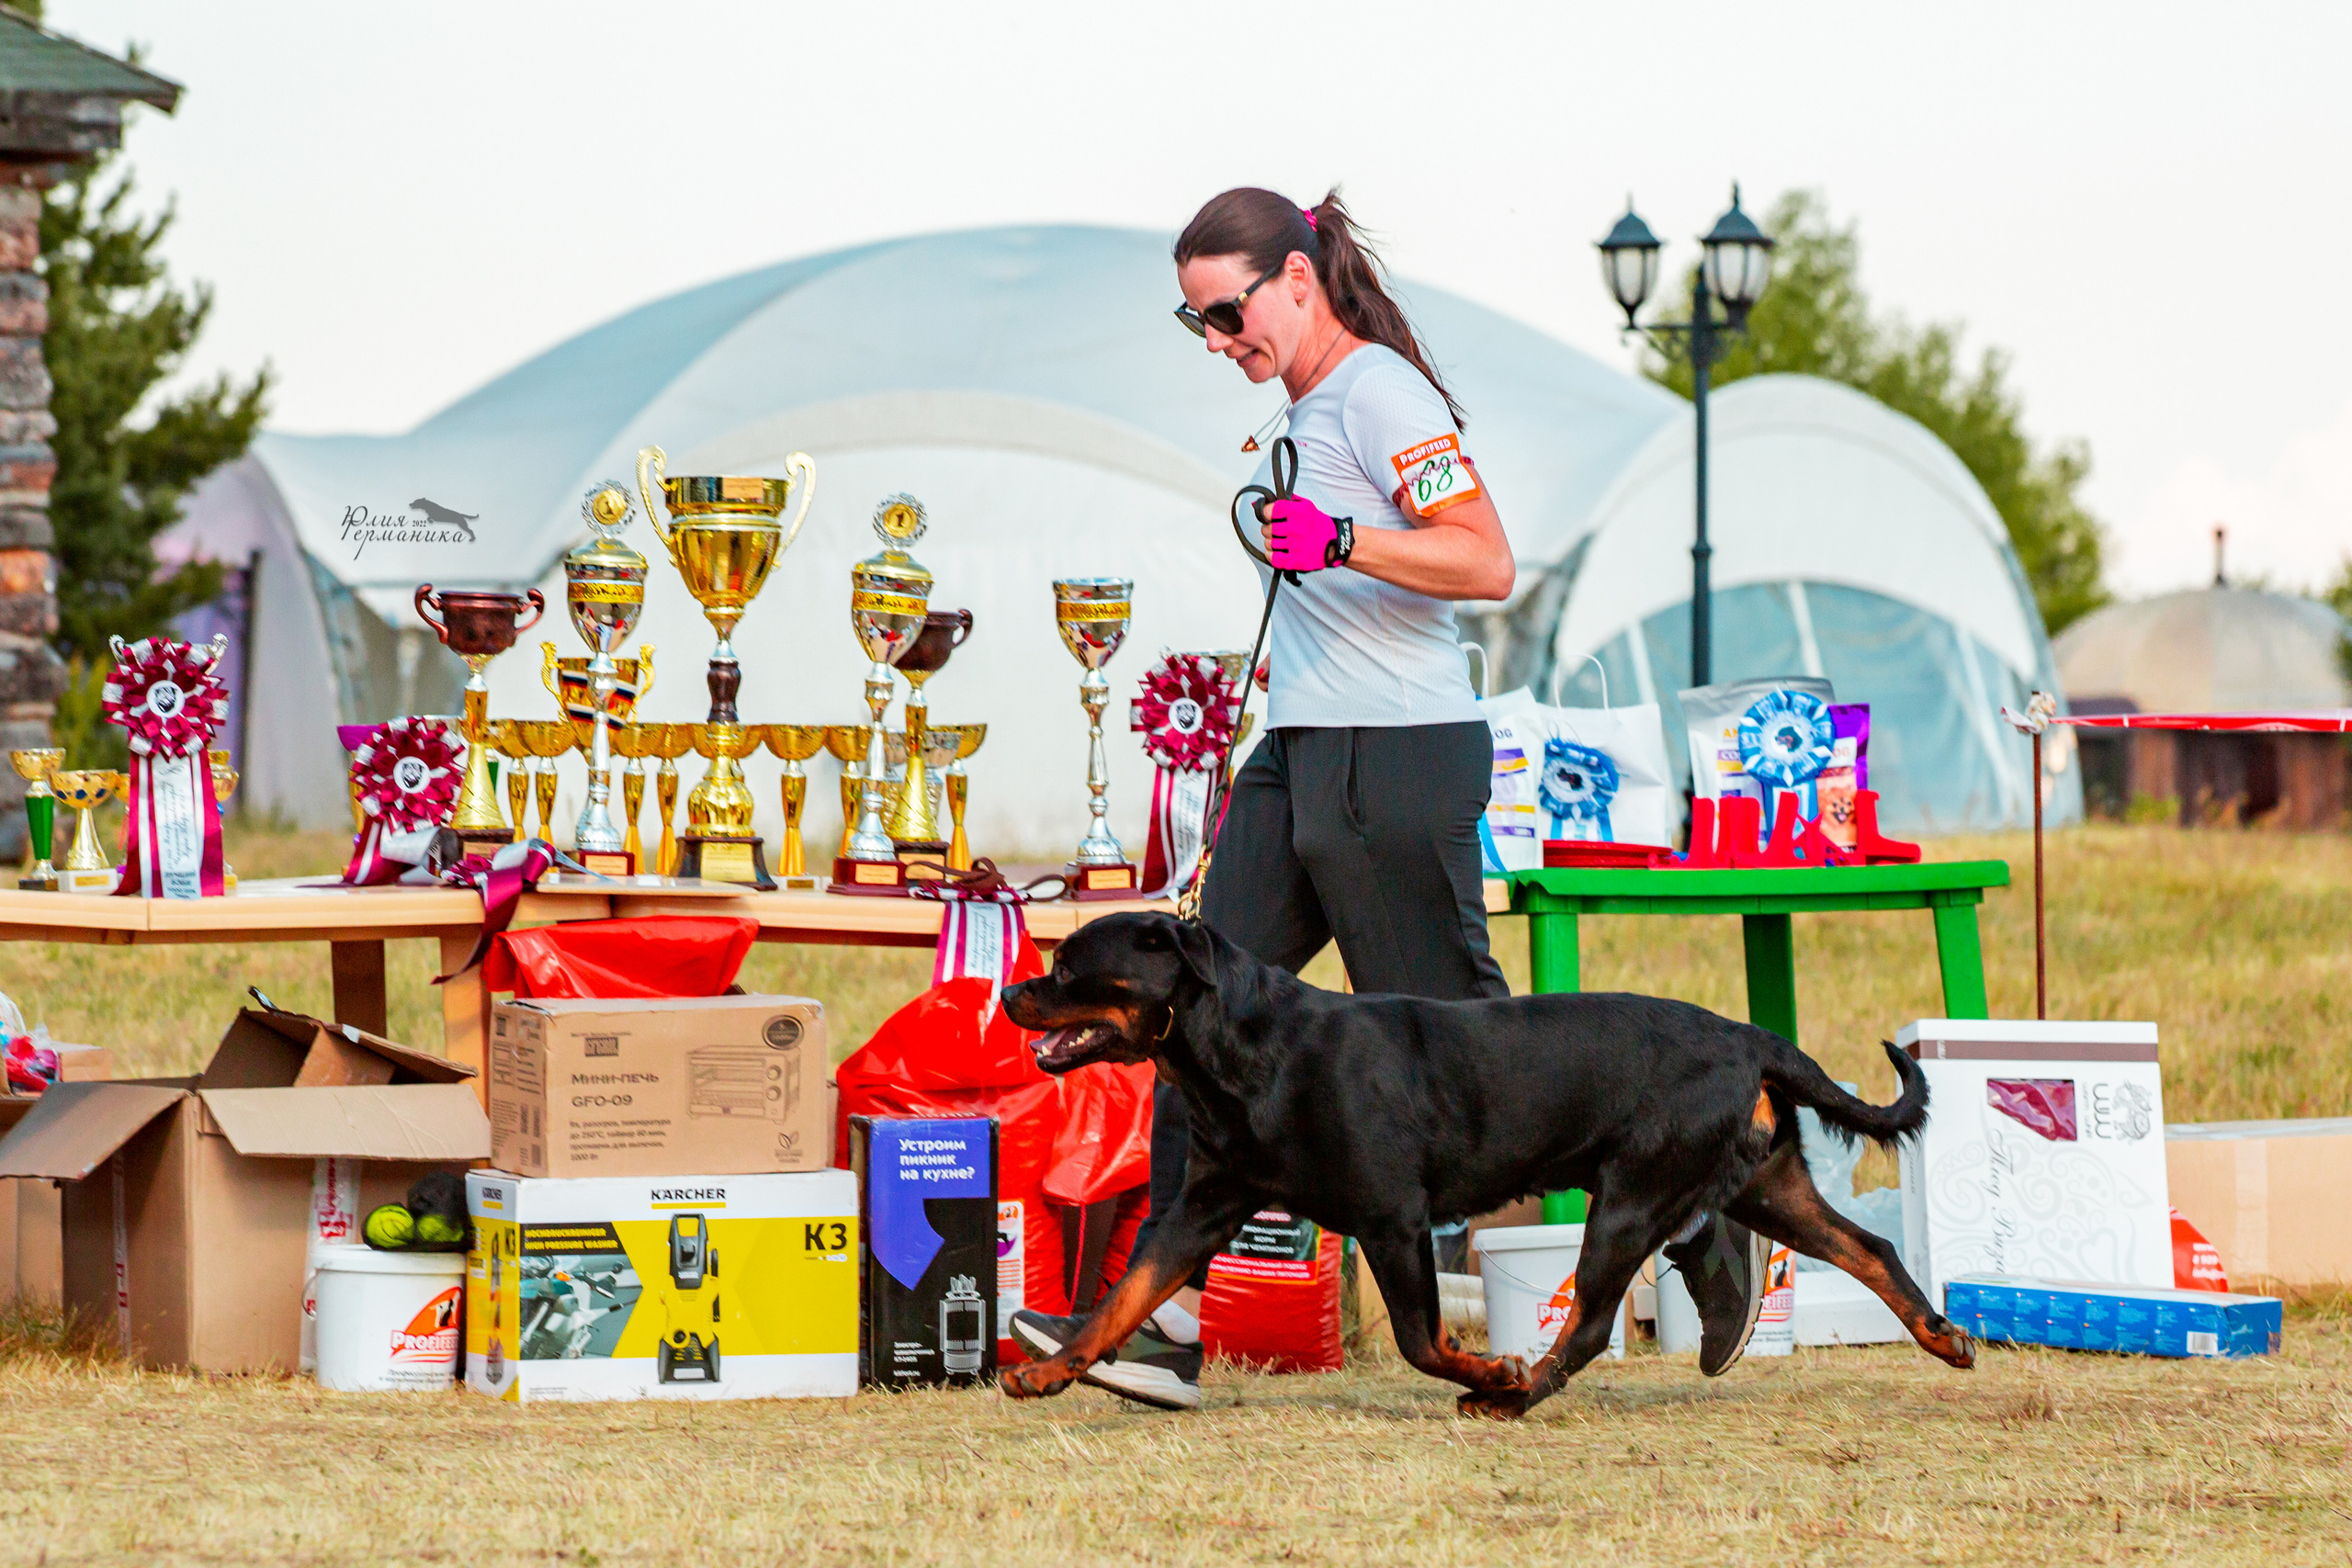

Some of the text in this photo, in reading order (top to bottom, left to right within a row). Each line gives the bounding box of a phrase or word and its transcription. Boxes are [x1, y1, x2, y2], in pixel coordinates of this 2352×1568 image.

[1399, 438, 1452, 467] PROFIFEED
[1418, 456, 1453, 502] 68
[571, 1093, 633, 1108] GFO-09
[899, 1138, 967, 1154] Устроим
[899, 1154, 957, 1167] пикник
[899, 1166, 976, 1183] на кухне?
[650, 1188, 727, 1201] KÄRCHER
